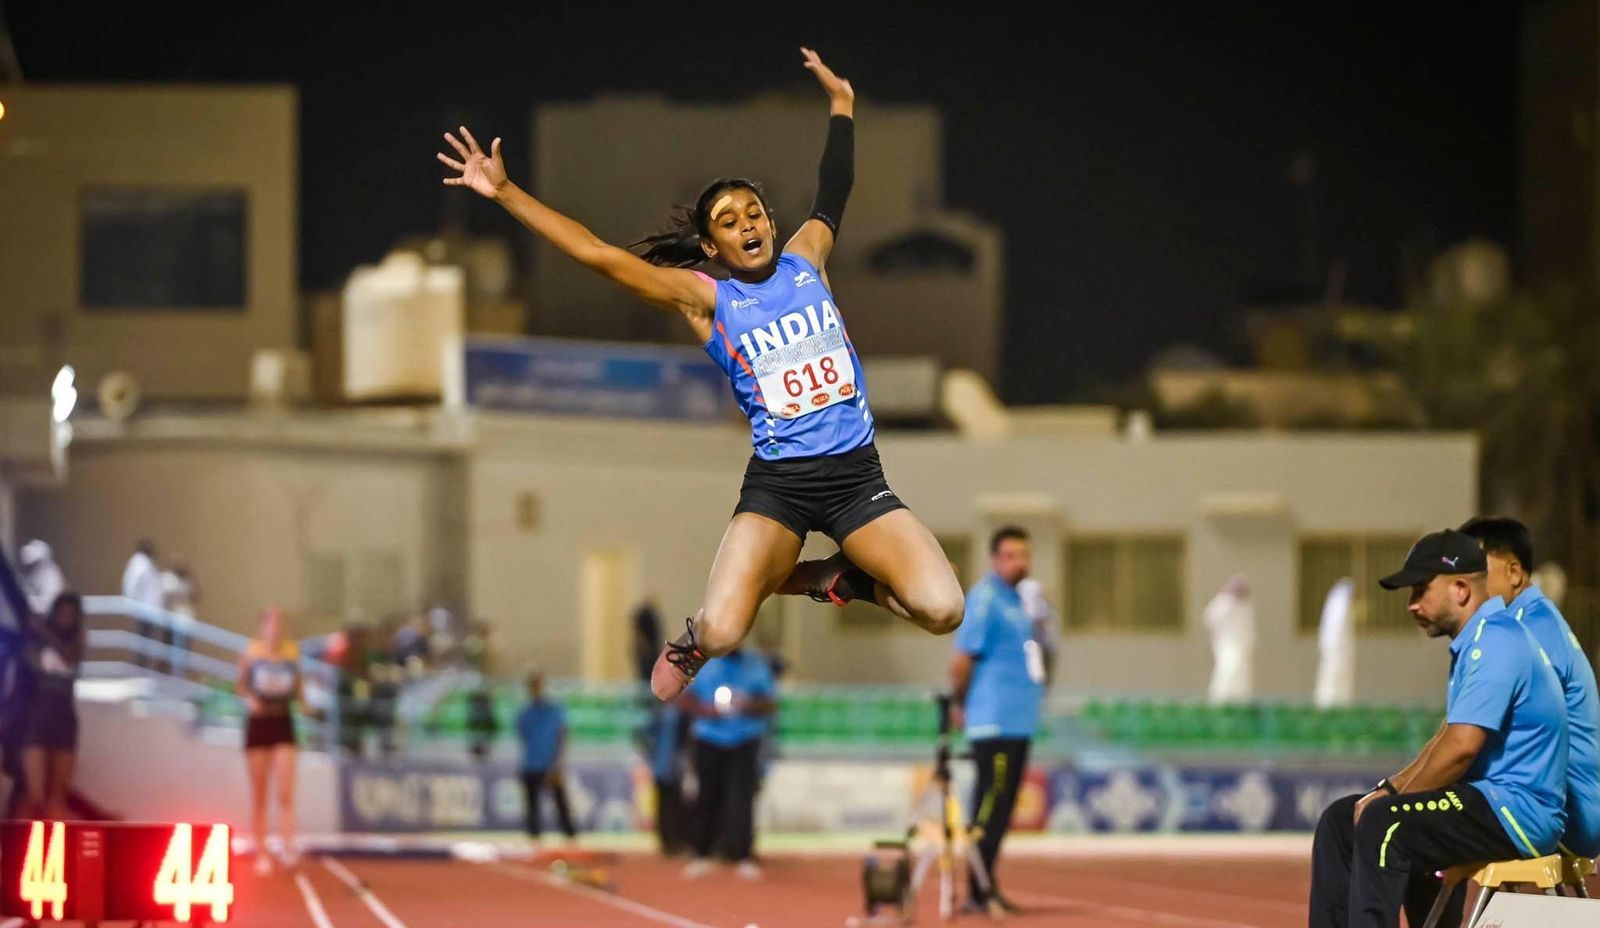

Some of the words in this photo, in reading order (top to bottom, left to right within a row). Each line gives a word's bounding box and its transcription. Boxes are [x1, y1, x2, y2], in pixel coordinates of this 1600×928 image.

[740, 300, 840, 360] INDIA
[783, 356, 839, 398] 618
[20, 821, 67, 921] 44
[153, 822, 234, 923] 44
